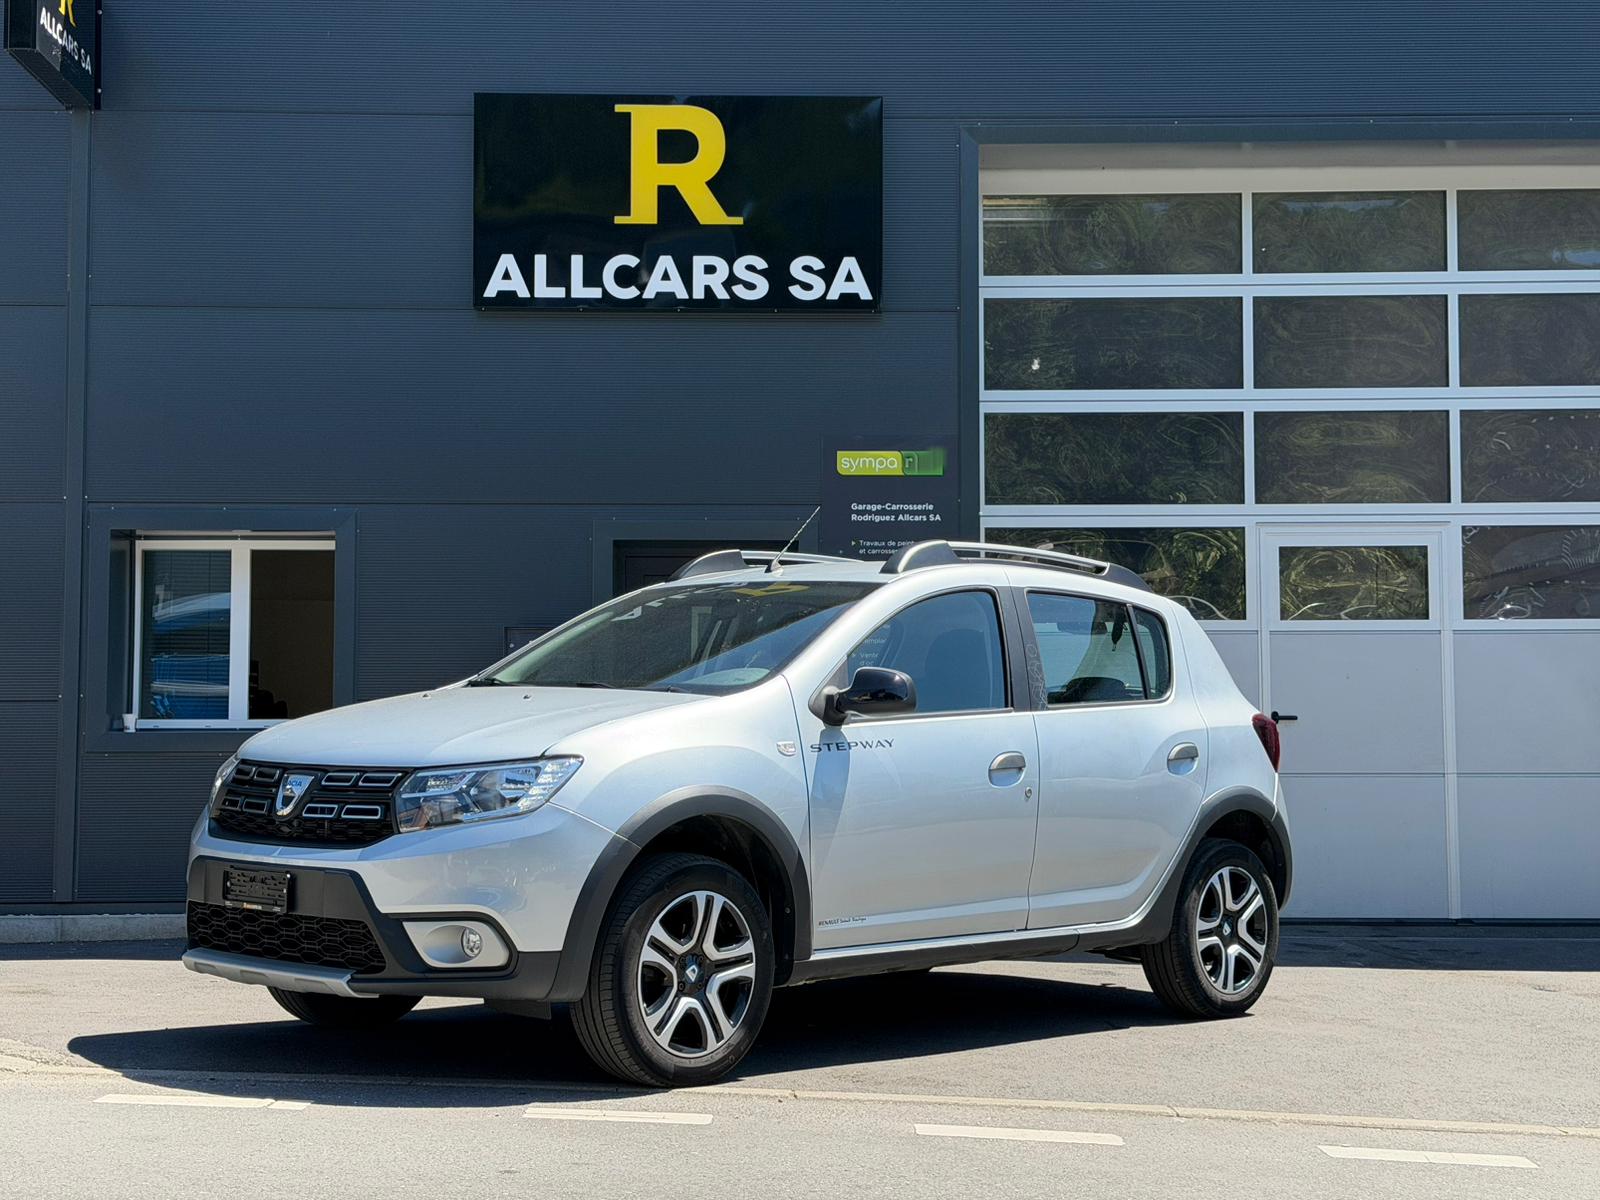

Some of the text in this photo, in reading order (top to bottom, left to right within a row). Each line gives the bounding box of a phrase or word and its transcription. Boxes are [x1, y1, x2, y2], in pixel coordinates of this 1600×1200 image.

[40, 6, 79, 60] ALLCARS
[80, 48, 92, 75] SA
[614, 103, 744, 225] R
[482, 253, 873, 301] ALLCARS SA
[841, 457, 898, 472] sympa
[850, 502, 934, 512] Garage-Carrosserie
[850, 513, 942, 522] Rodriguez Allcars SA
[810, 738, 895, 753] STEPWAY
